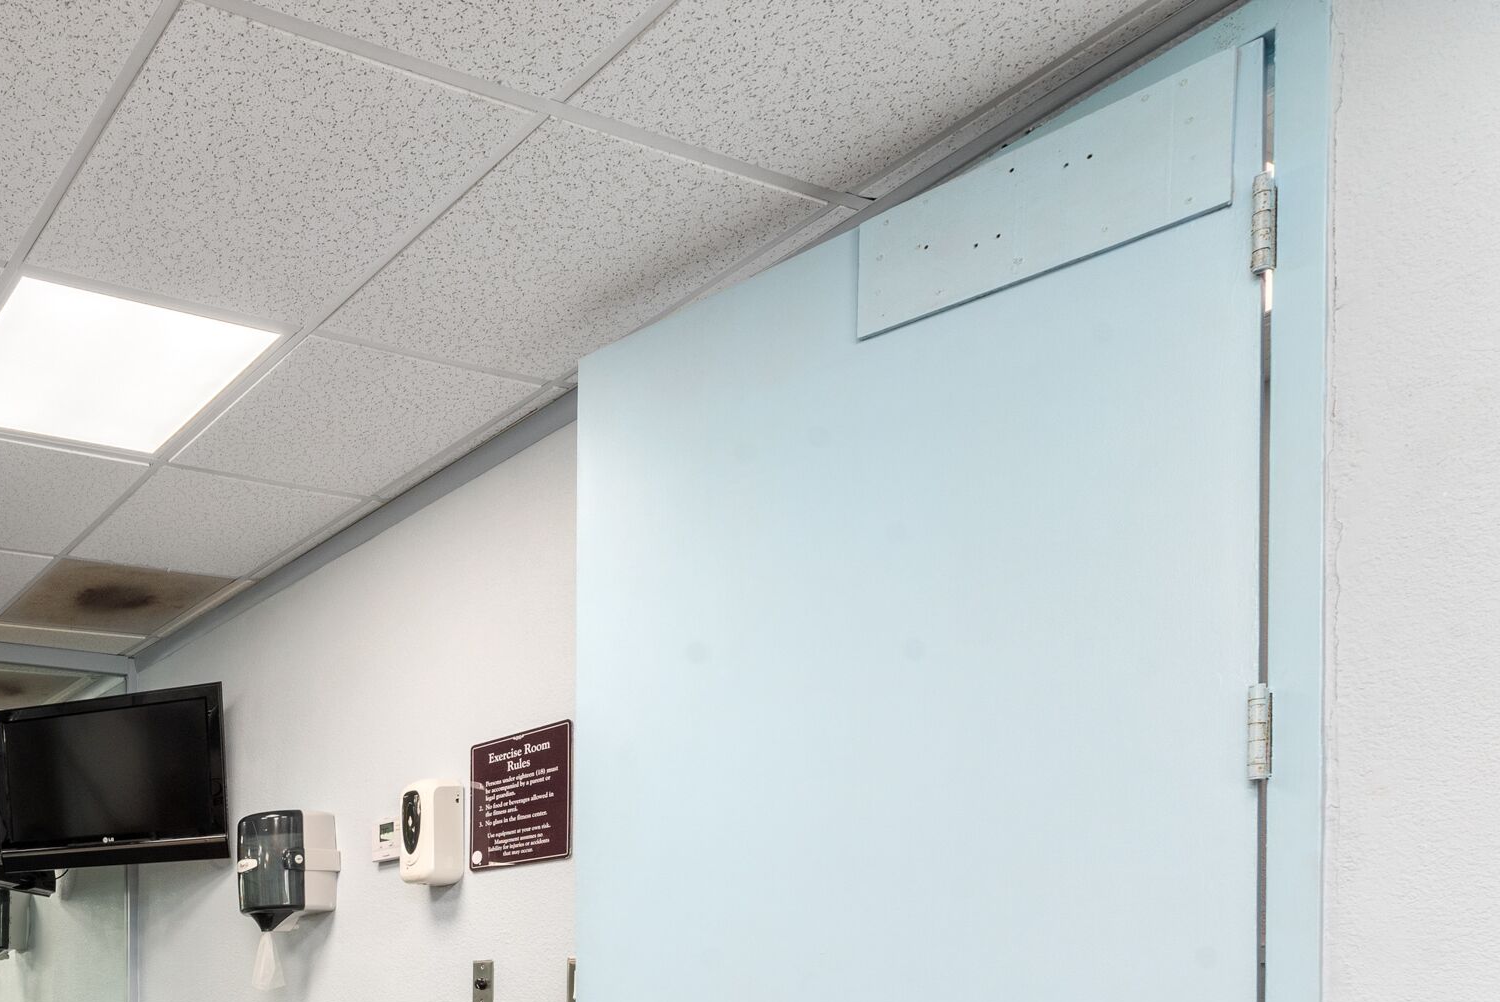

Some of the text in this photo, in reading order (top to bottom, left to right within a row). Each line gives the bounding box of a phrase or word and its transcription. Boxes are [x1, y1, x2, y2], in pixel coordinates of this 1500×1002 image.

[488, 741, 550, 764] Exercise Room
[507, 758, 530, 772] Rules
[516, 772, 534, 781] eighteen
[492, 782, 519, 793] accompanied
[530, 777, 544, 786] parent
[496, 790, 516, 800] guardian.
[509, 797, 530, 806] beverages
[531, 792, 548, 801] allowed
[494, 837, 519, 845] Management
